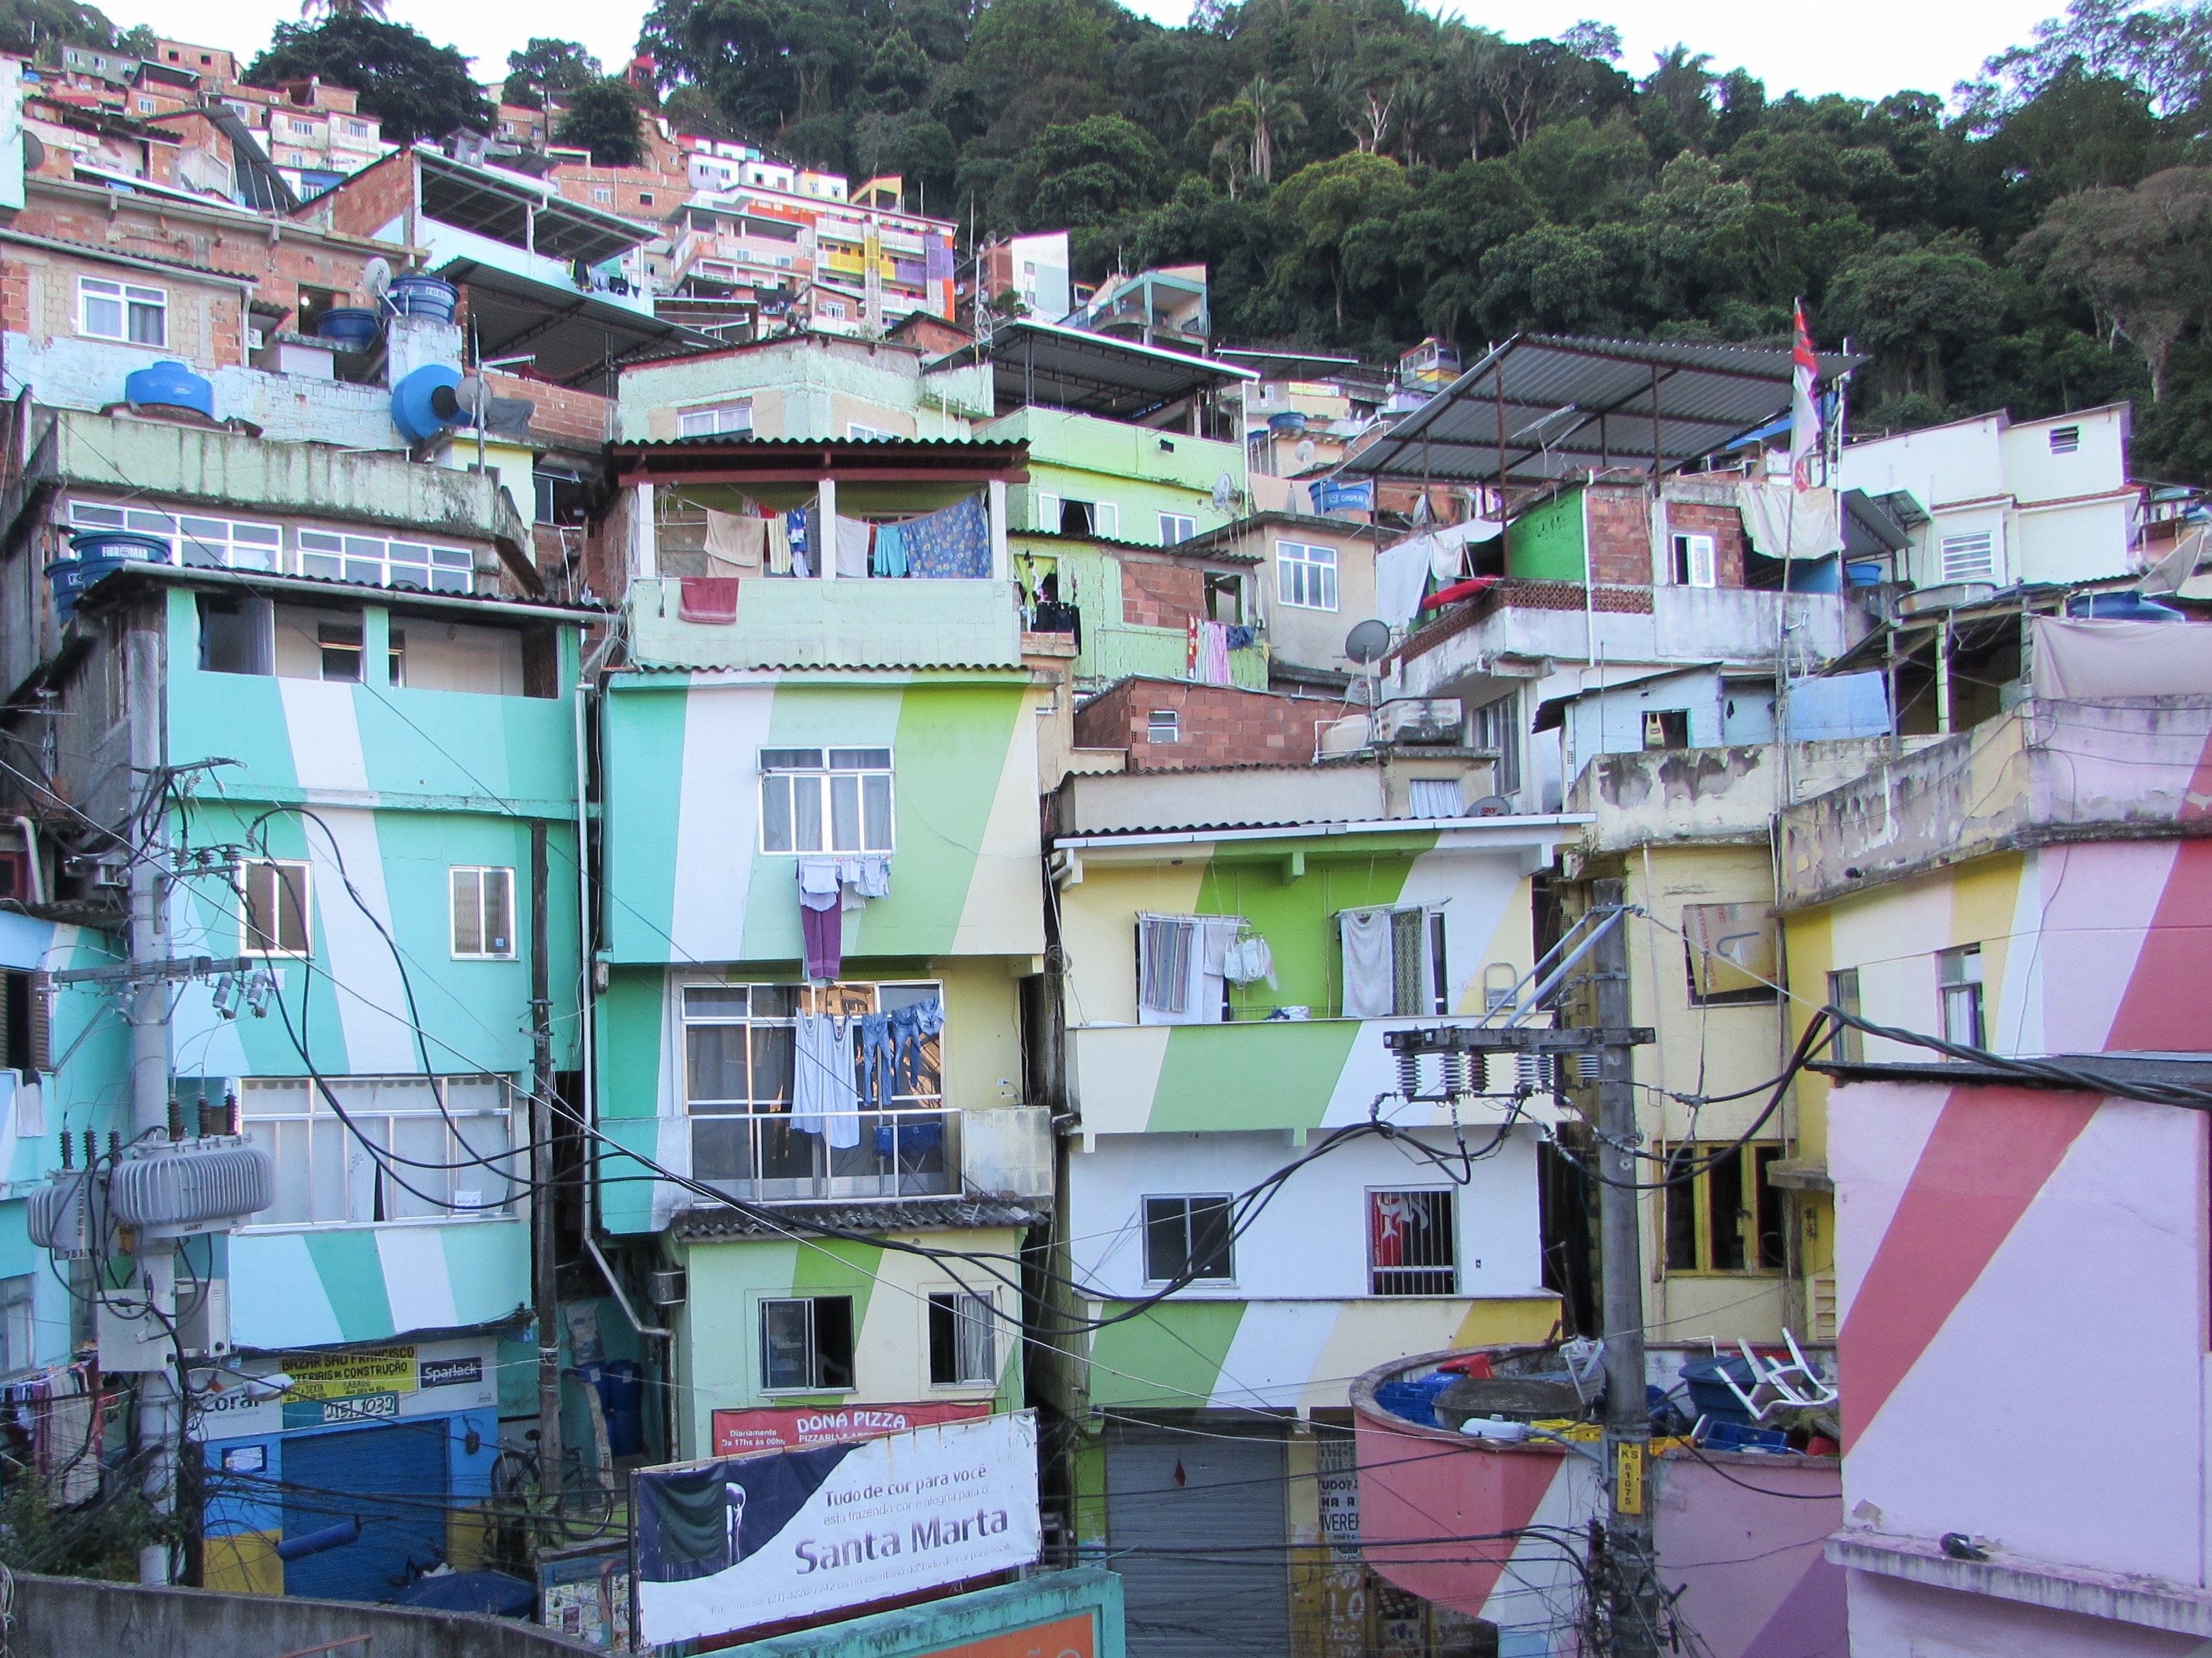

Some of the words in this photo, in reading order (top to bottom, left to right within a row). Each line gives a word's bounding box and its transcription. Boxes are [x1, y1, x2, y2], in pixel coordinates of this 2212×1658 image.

[425, 1363, 478, 1382] Sparlack
[730, 1428, 777, 1438] Diariamente
[797, 1412, 848, 1434] DONA
[854, 1411, 907, 1429] PIZZA
[1621, 1450, 1638, 1459] KS
[825, 1489, 861, 1507] Tudo
[863, 1485, 884, 1500] de
[887, 1481, 913, 1496] cor
[915, 1472, 949, 1495] para
[953, 1463, 988, 1484] você
[848, 1502, 893, 1522] trazendo
[895, 1500, 913, 1512] cor
[924, 1491, 957, 1507] alegria
[958, 1489, 979, 1502] para
[795, 1529, 901, 1575] Santa
[911, 1507, 1009, 1553] Marta
